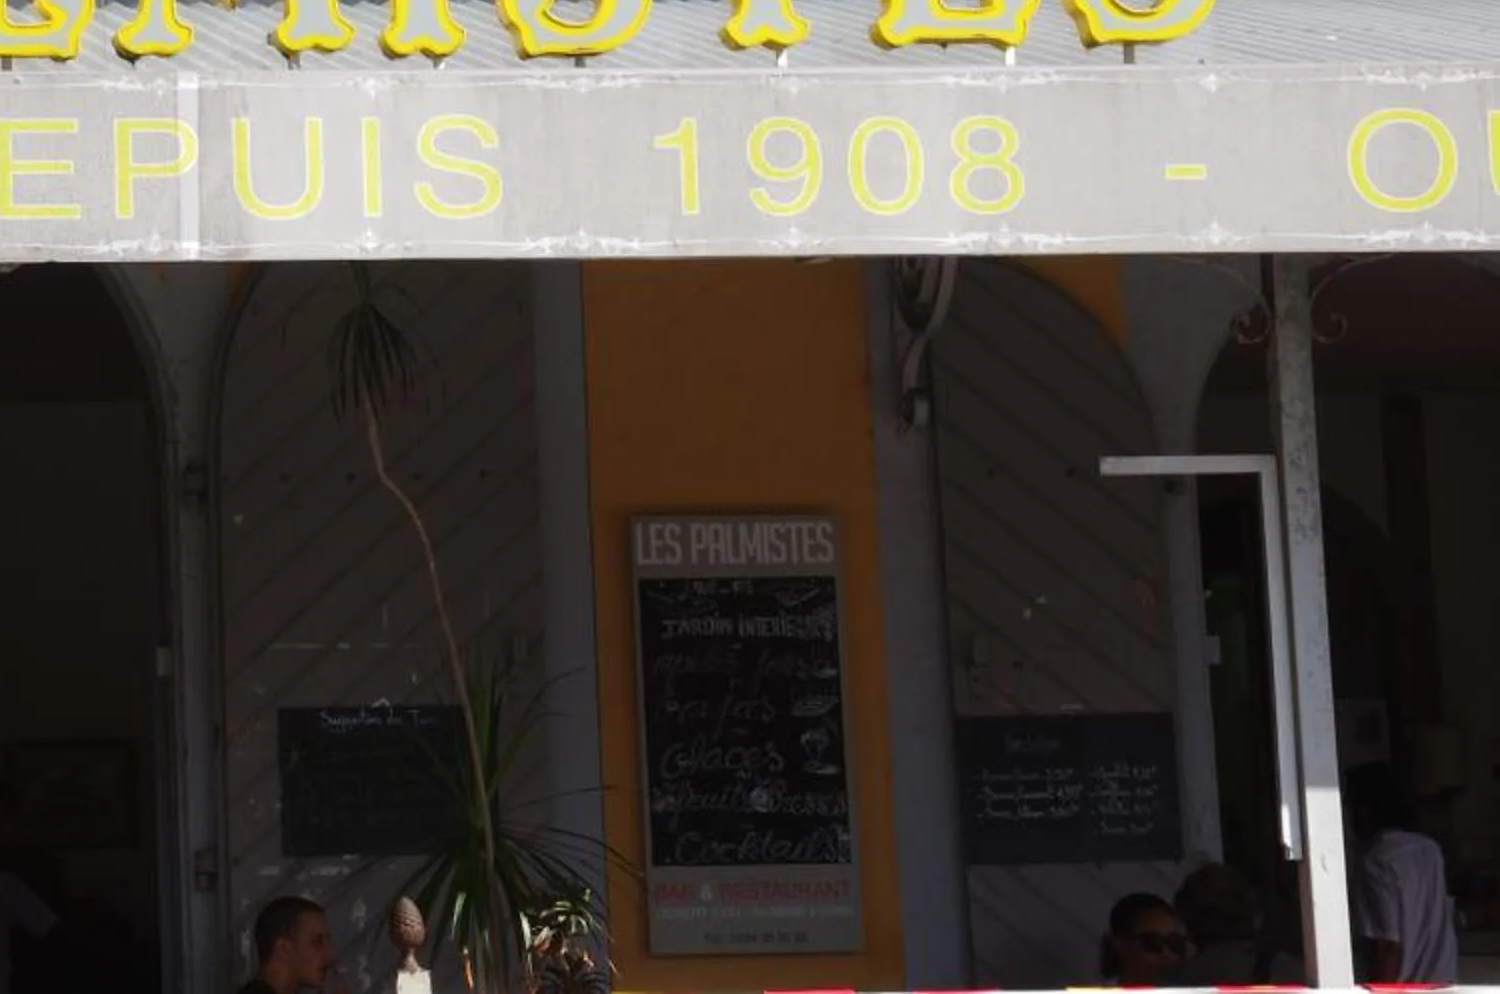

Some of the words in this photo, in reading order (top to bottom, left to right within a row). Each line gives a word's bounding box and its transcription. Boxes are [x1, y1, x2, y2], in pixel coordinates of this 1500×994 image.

[652, 115, 1025, 216] 1908
[1346, 107, 1500, 213] O
[636, 522, 682, 565] LES
[689, 520, 834, 565] PALMISTES
